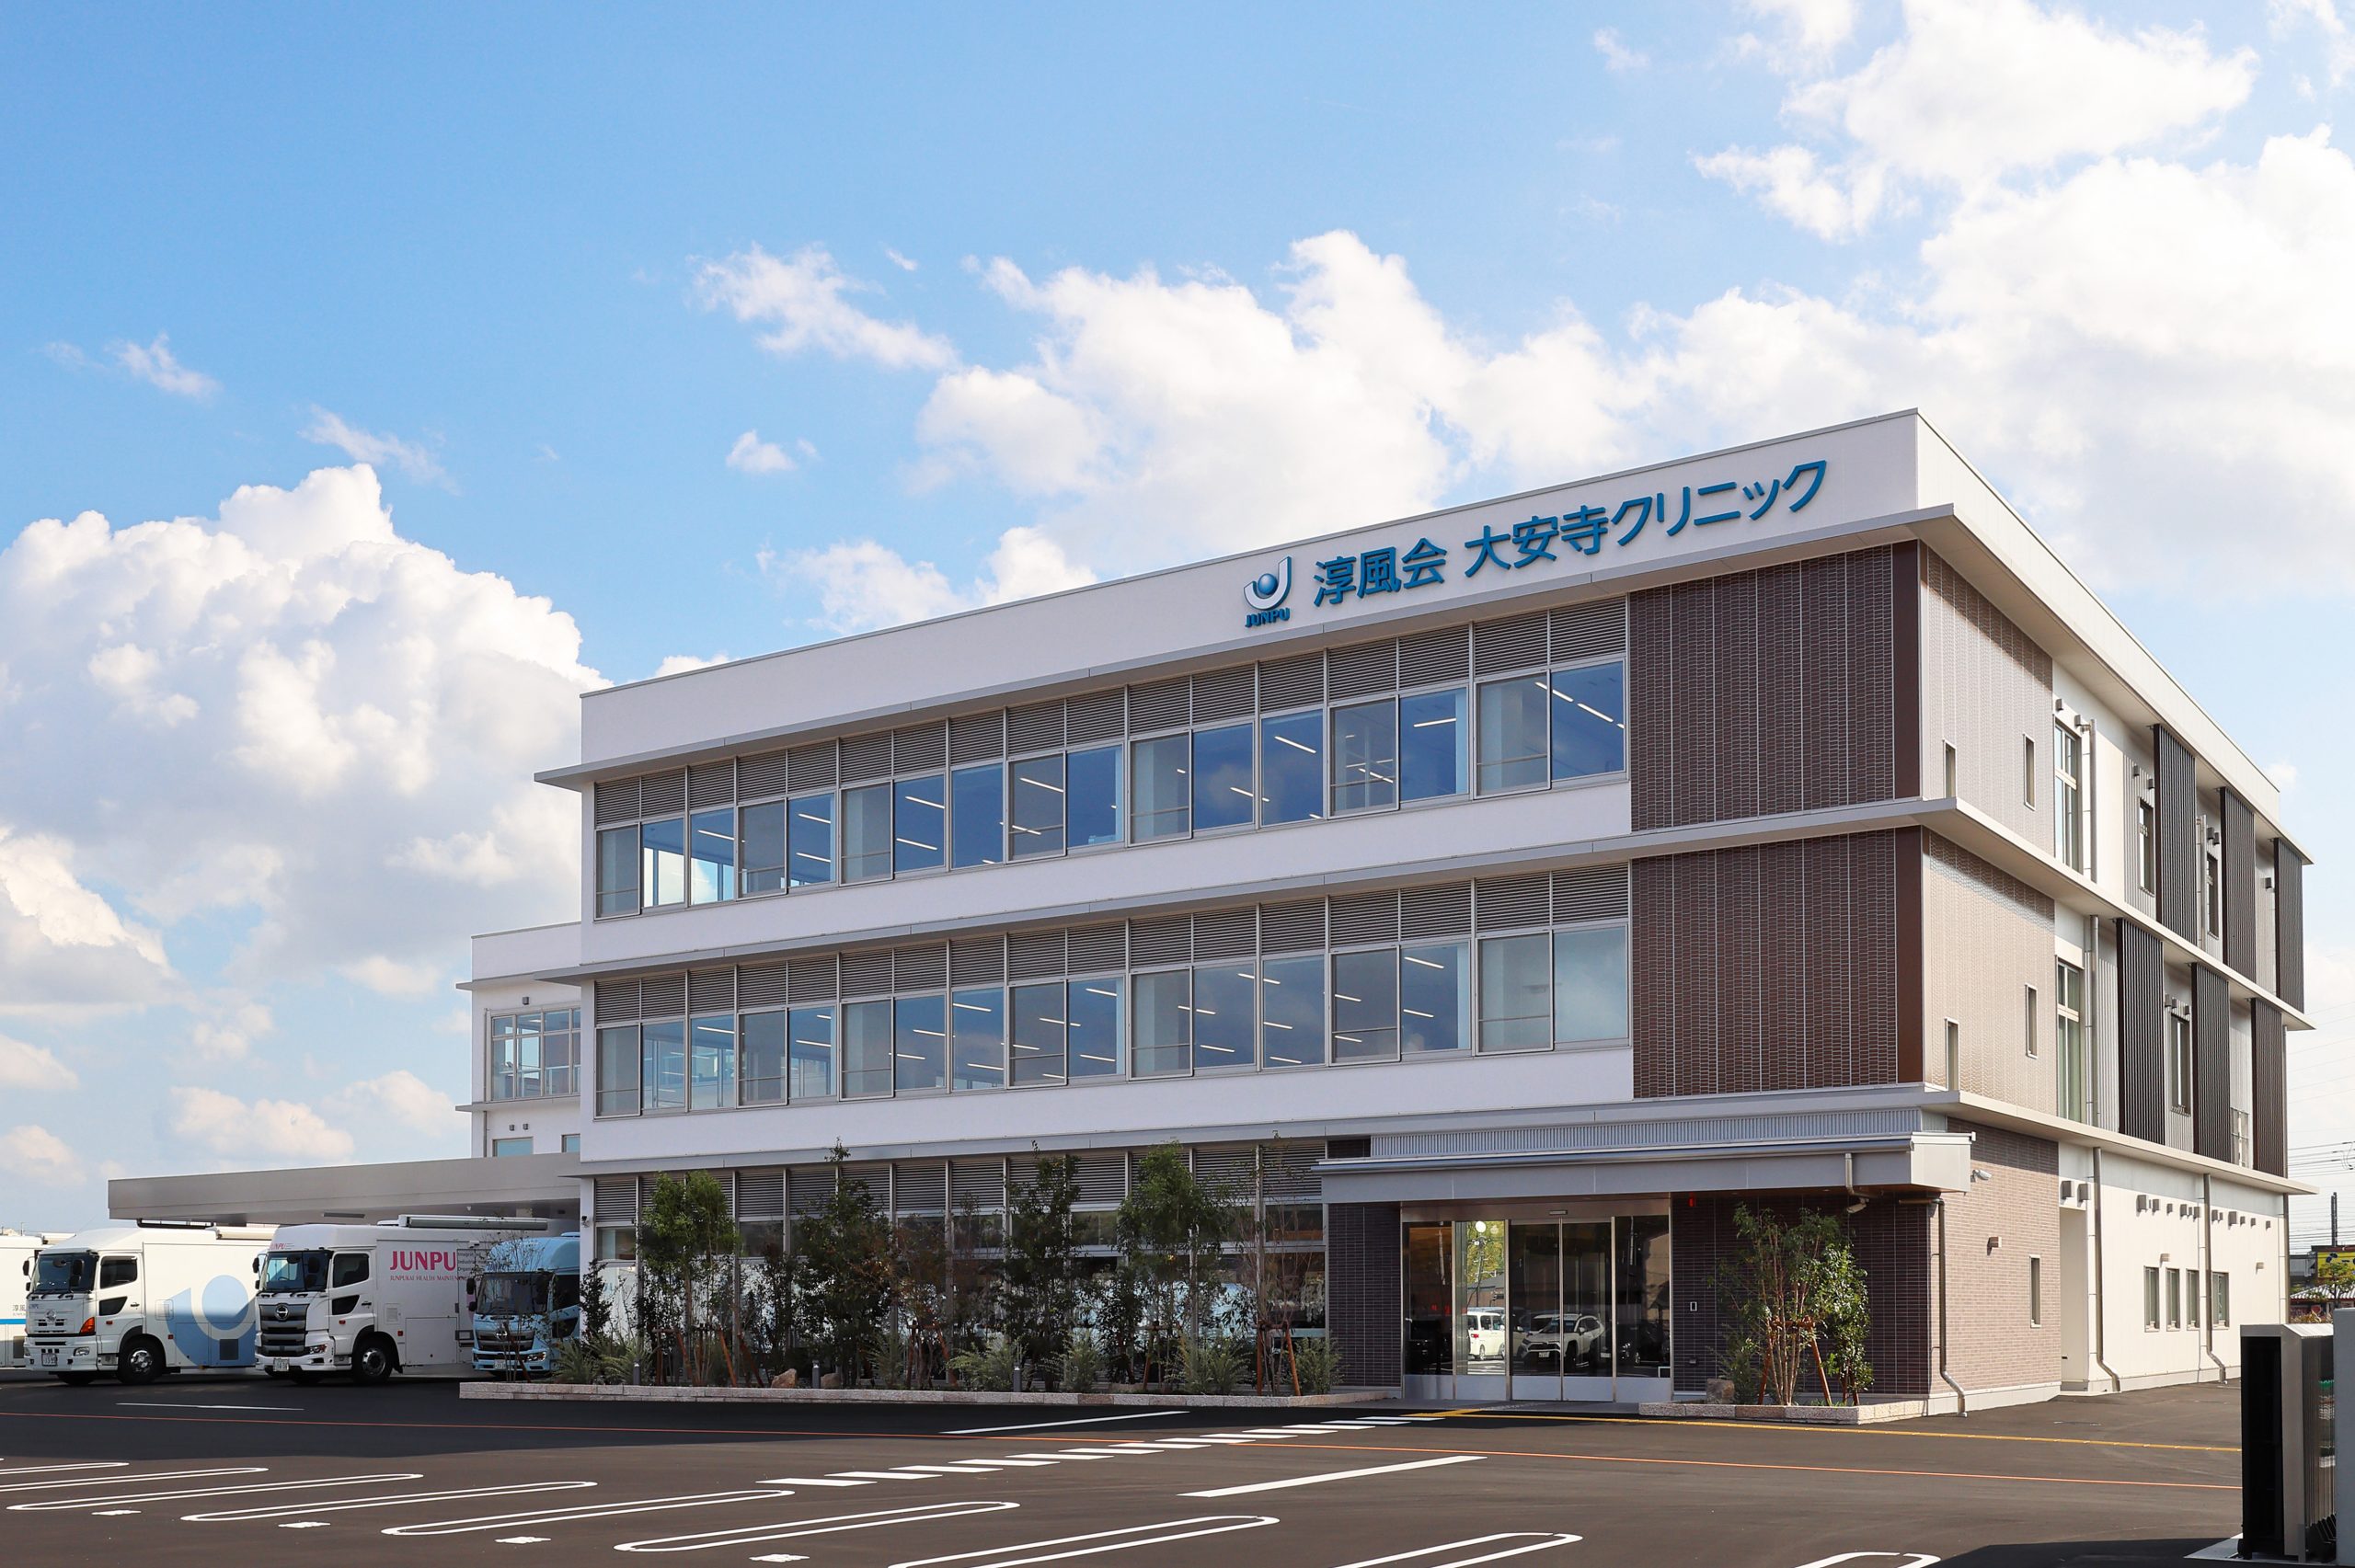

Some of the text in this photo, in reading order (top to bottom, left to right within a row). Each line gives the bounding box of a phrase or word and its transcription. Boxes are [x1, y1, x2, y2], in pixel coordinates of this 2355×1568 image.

[1313, 460, 1827, 608] 淳風会 大安寺クリニック
[1245, 607, 1291, 628] JUNPU
[389, 1251, 456, 1271] JUNPU
